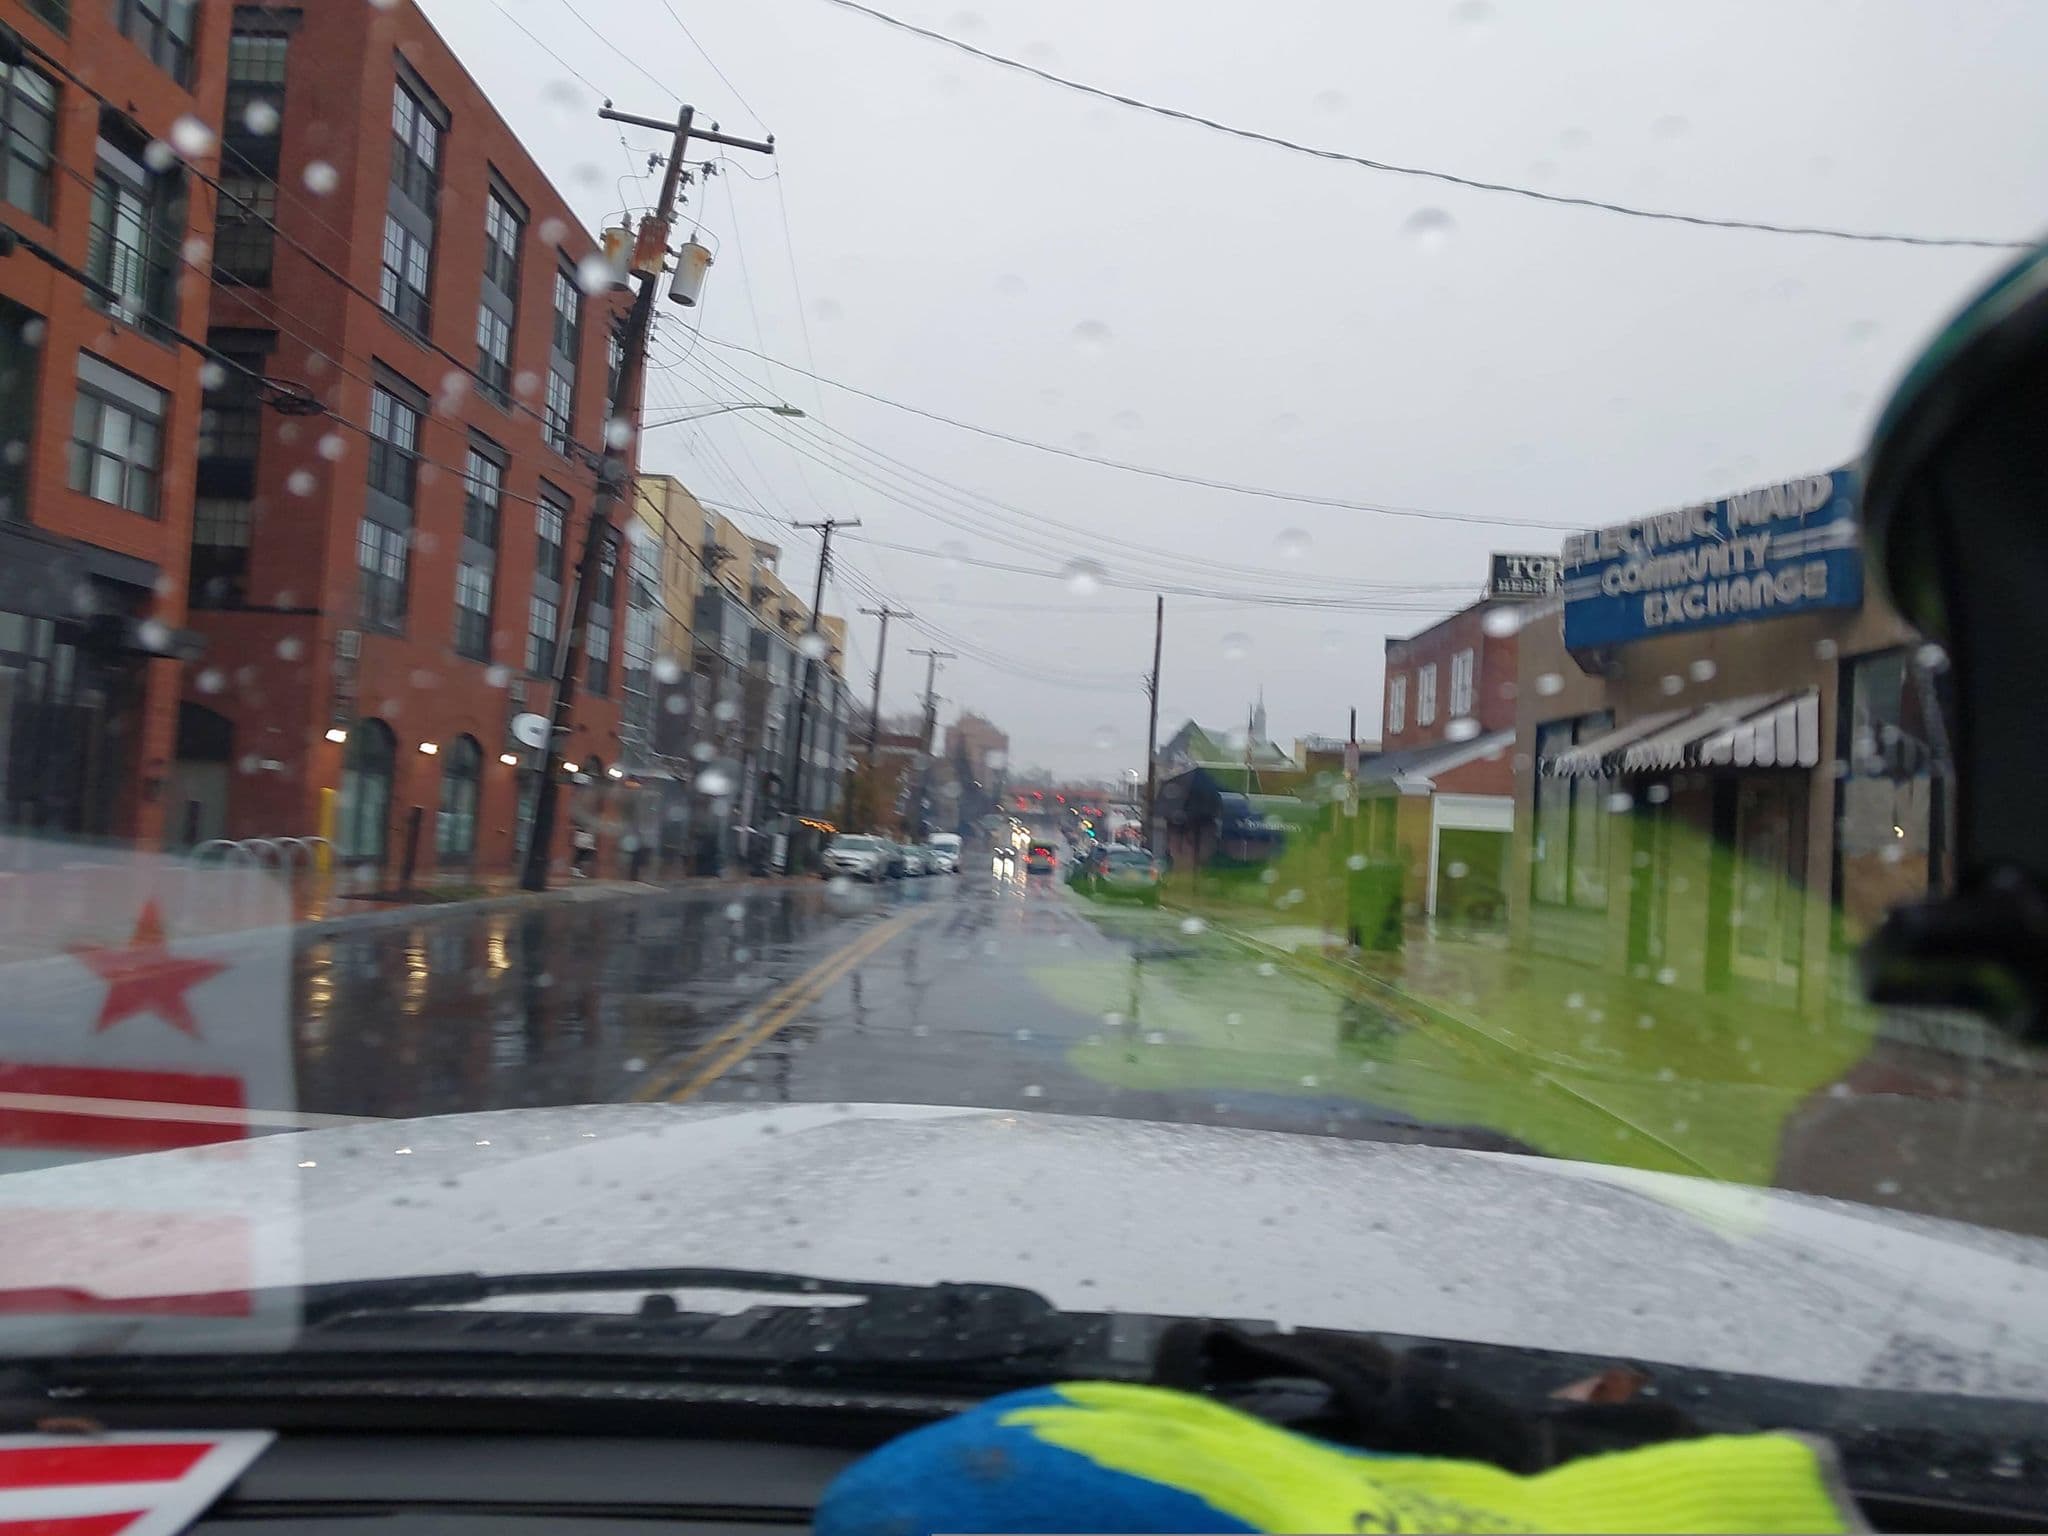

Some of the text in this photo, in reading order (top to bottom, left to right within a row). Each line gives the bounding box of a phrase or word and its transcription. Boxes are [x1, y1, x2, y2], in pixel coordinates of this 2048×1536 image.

[1565, 474, 1833, 566] ELECTRIC MAID
[1601, 531, 1769, 596] COMMUNITY
[1644, 560, 1827, 627] EXCHANGE
